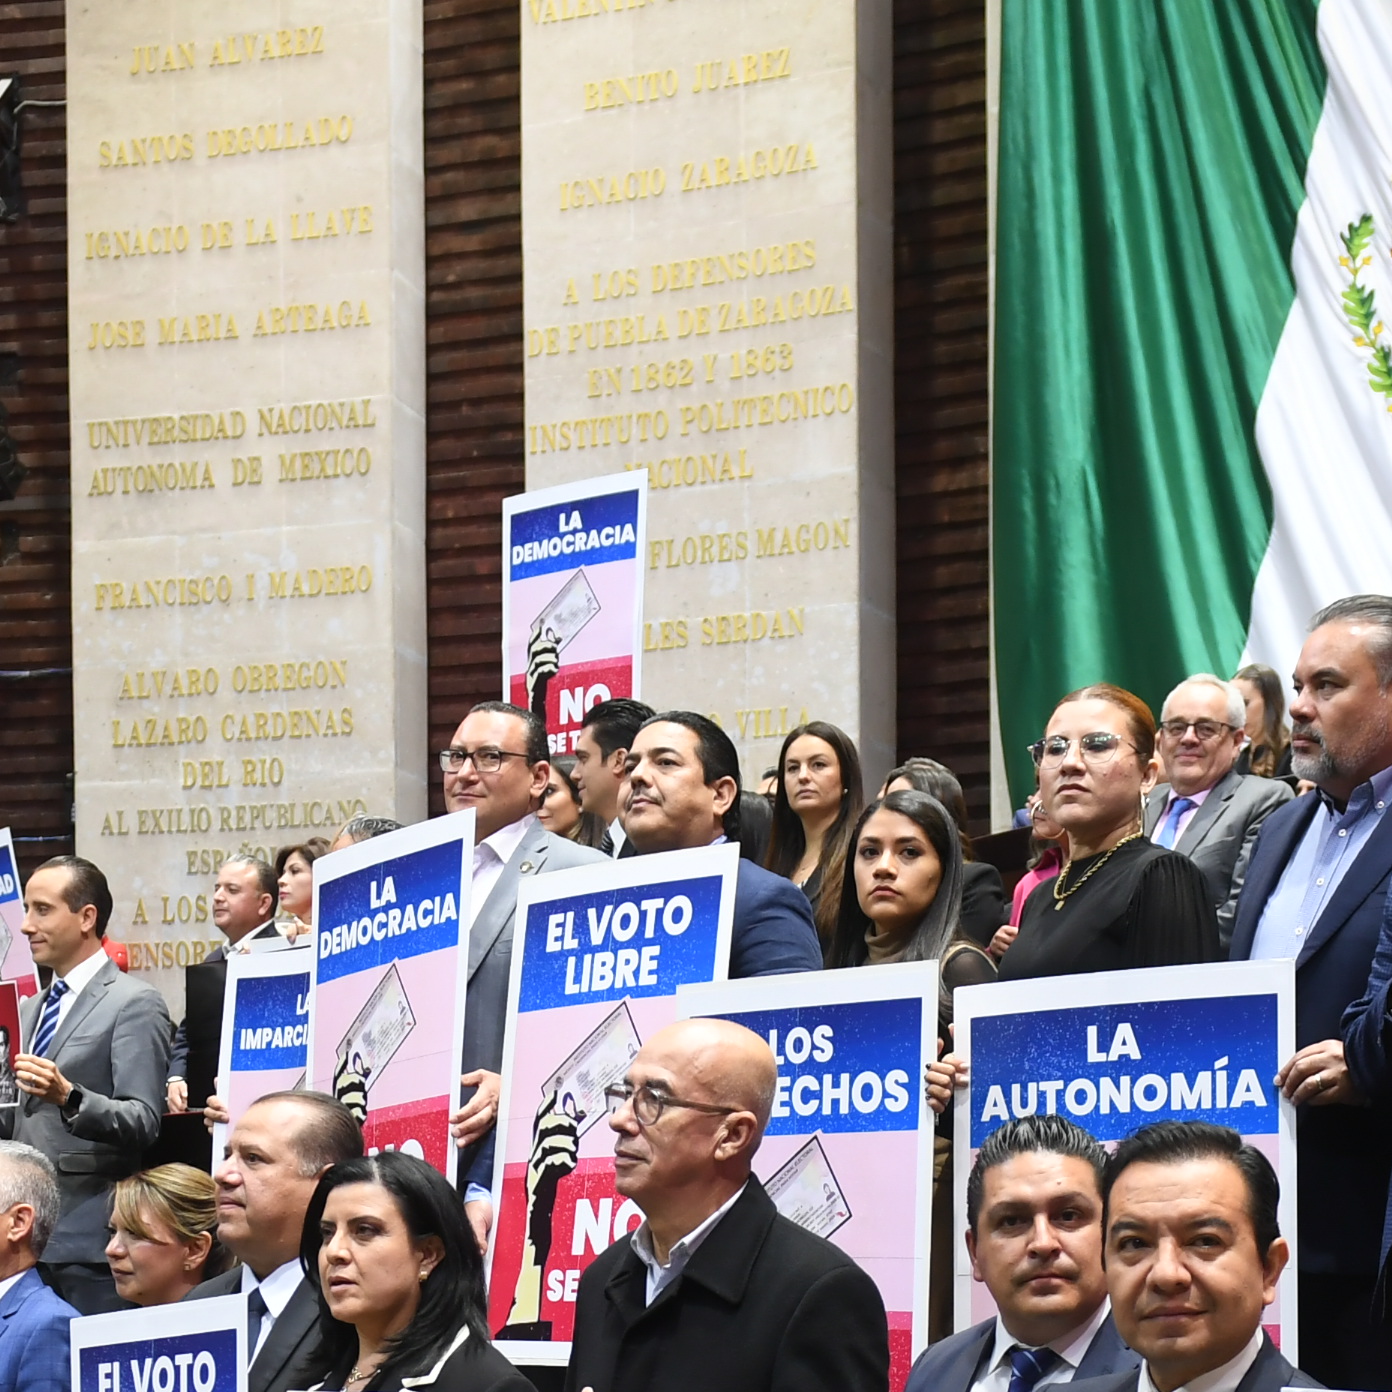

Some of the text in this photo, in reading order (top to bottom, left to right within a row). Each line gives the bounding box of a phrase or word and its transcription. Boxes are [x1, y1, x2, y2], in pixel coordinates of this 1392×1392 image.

[130, 25, 324, 75] JUAN ALVAREZ
[584, 48, 791, 111] BENITO JUAREZ
[99, 115, 353, 167] SANTOS DEGOLLADO
[560, 143, 818, 212] IGNACIO ZARAGOZA
[85, 205, 373, 260] IGNACIO DE LA LLAVE
[563, 239, 816, 306] A LOS DEFENSORES
[88, 300, 371, 350] JOSE MARIA ARTEAGA
[528, 284, 853, 357] DE PUEBLA DE ZARAGOZA
[588, 343, 793, 398] EN 1862 Y 1863
[87, 399, 376, 449] UNIVERSIDAD NACIONAL
[530, 382, 853, 455] INSTITUTO POLITECNICO
[88, 447, 371, 496] AUTONOMA DE MEXICO
[625, 448, 754, 489] ACIONAL
[512, 523, 636, 566] DEMOCRACIA
[560, 511, 582, 533] LA
[650, 518, 850, 570] FLORES MAGON
[95, 565, 372, 610] FRANCISCO I MADERO
[701, 607, 806, 646] SERDAN
[119, 660, 347, 700] ALVARO OBREGON
[112, 707, 354, 747] LAZARO CARDENAS
[182, 757, 284, 790] DEL RIO
[101, 811, 129, 836] AL
[137, 806, 212, 834] EXILIO
[133, 895, 208, 924] A LOS
[371, 876, 396, 908] LA
[319, 892, 458, 959] DEMOCRACIA
[546, 895, 692, 952] EL VOTO
[565, 946, 660, 994] LIBRE
[769, 1025, 834, 1065] LOS
[1088, 1023, 1141, 1062] LA
[771, 1069, 909, 1117] ECHOS
[982, 1056, 1267, 1121] AUTONOMÍA
